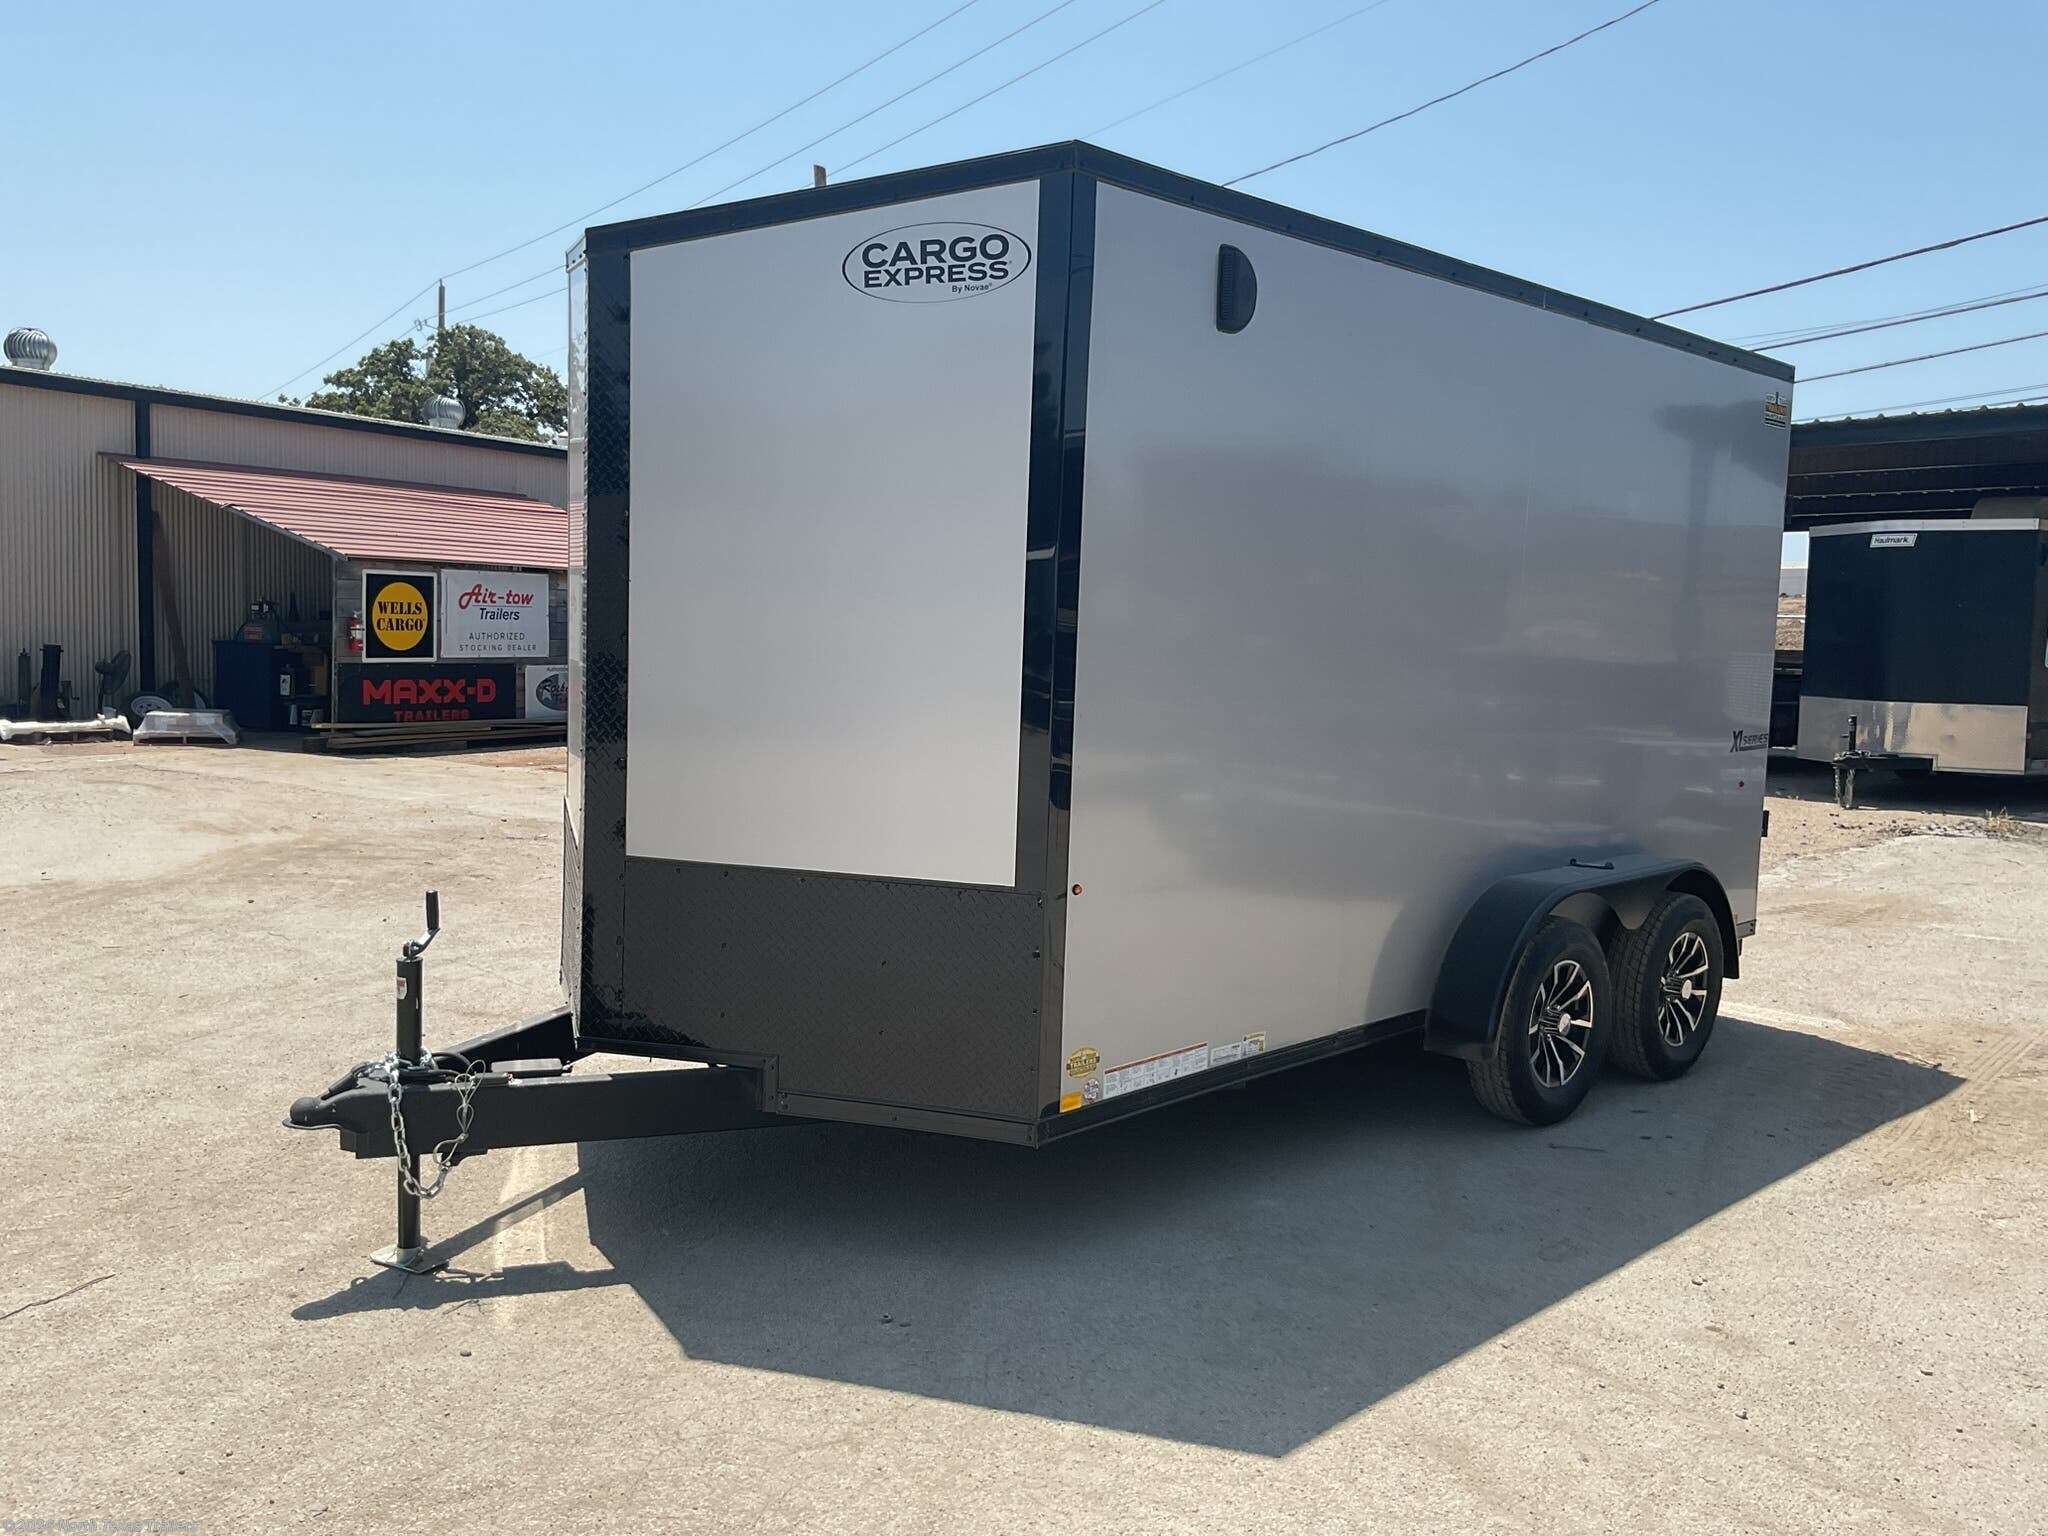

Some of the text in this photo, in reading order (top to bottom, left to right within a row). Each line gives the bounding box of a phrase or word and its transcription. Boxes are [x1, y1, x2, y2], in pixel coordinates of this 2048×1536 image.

[862, 234, 1010, 269] CARGO
[864, 261, 1009, 288] EXPRESS
[951, 285, 963, 294] By
[458, 584, 534, 610] Air-tow
[377, 601, 423, 615] WELLS
[480, 608, 520, 620] Trailers
[376, 618, 424, 632] CARGO
[469, 632, 526, 641] AUTHORIZED
[459, 644, 537, 652] STOCKING DEALER
[362, 678, 497, 706] MAXX-D
[393, 709, 470, 723] TRAILERS
[1743, 733, 1768, 746] SERIES
